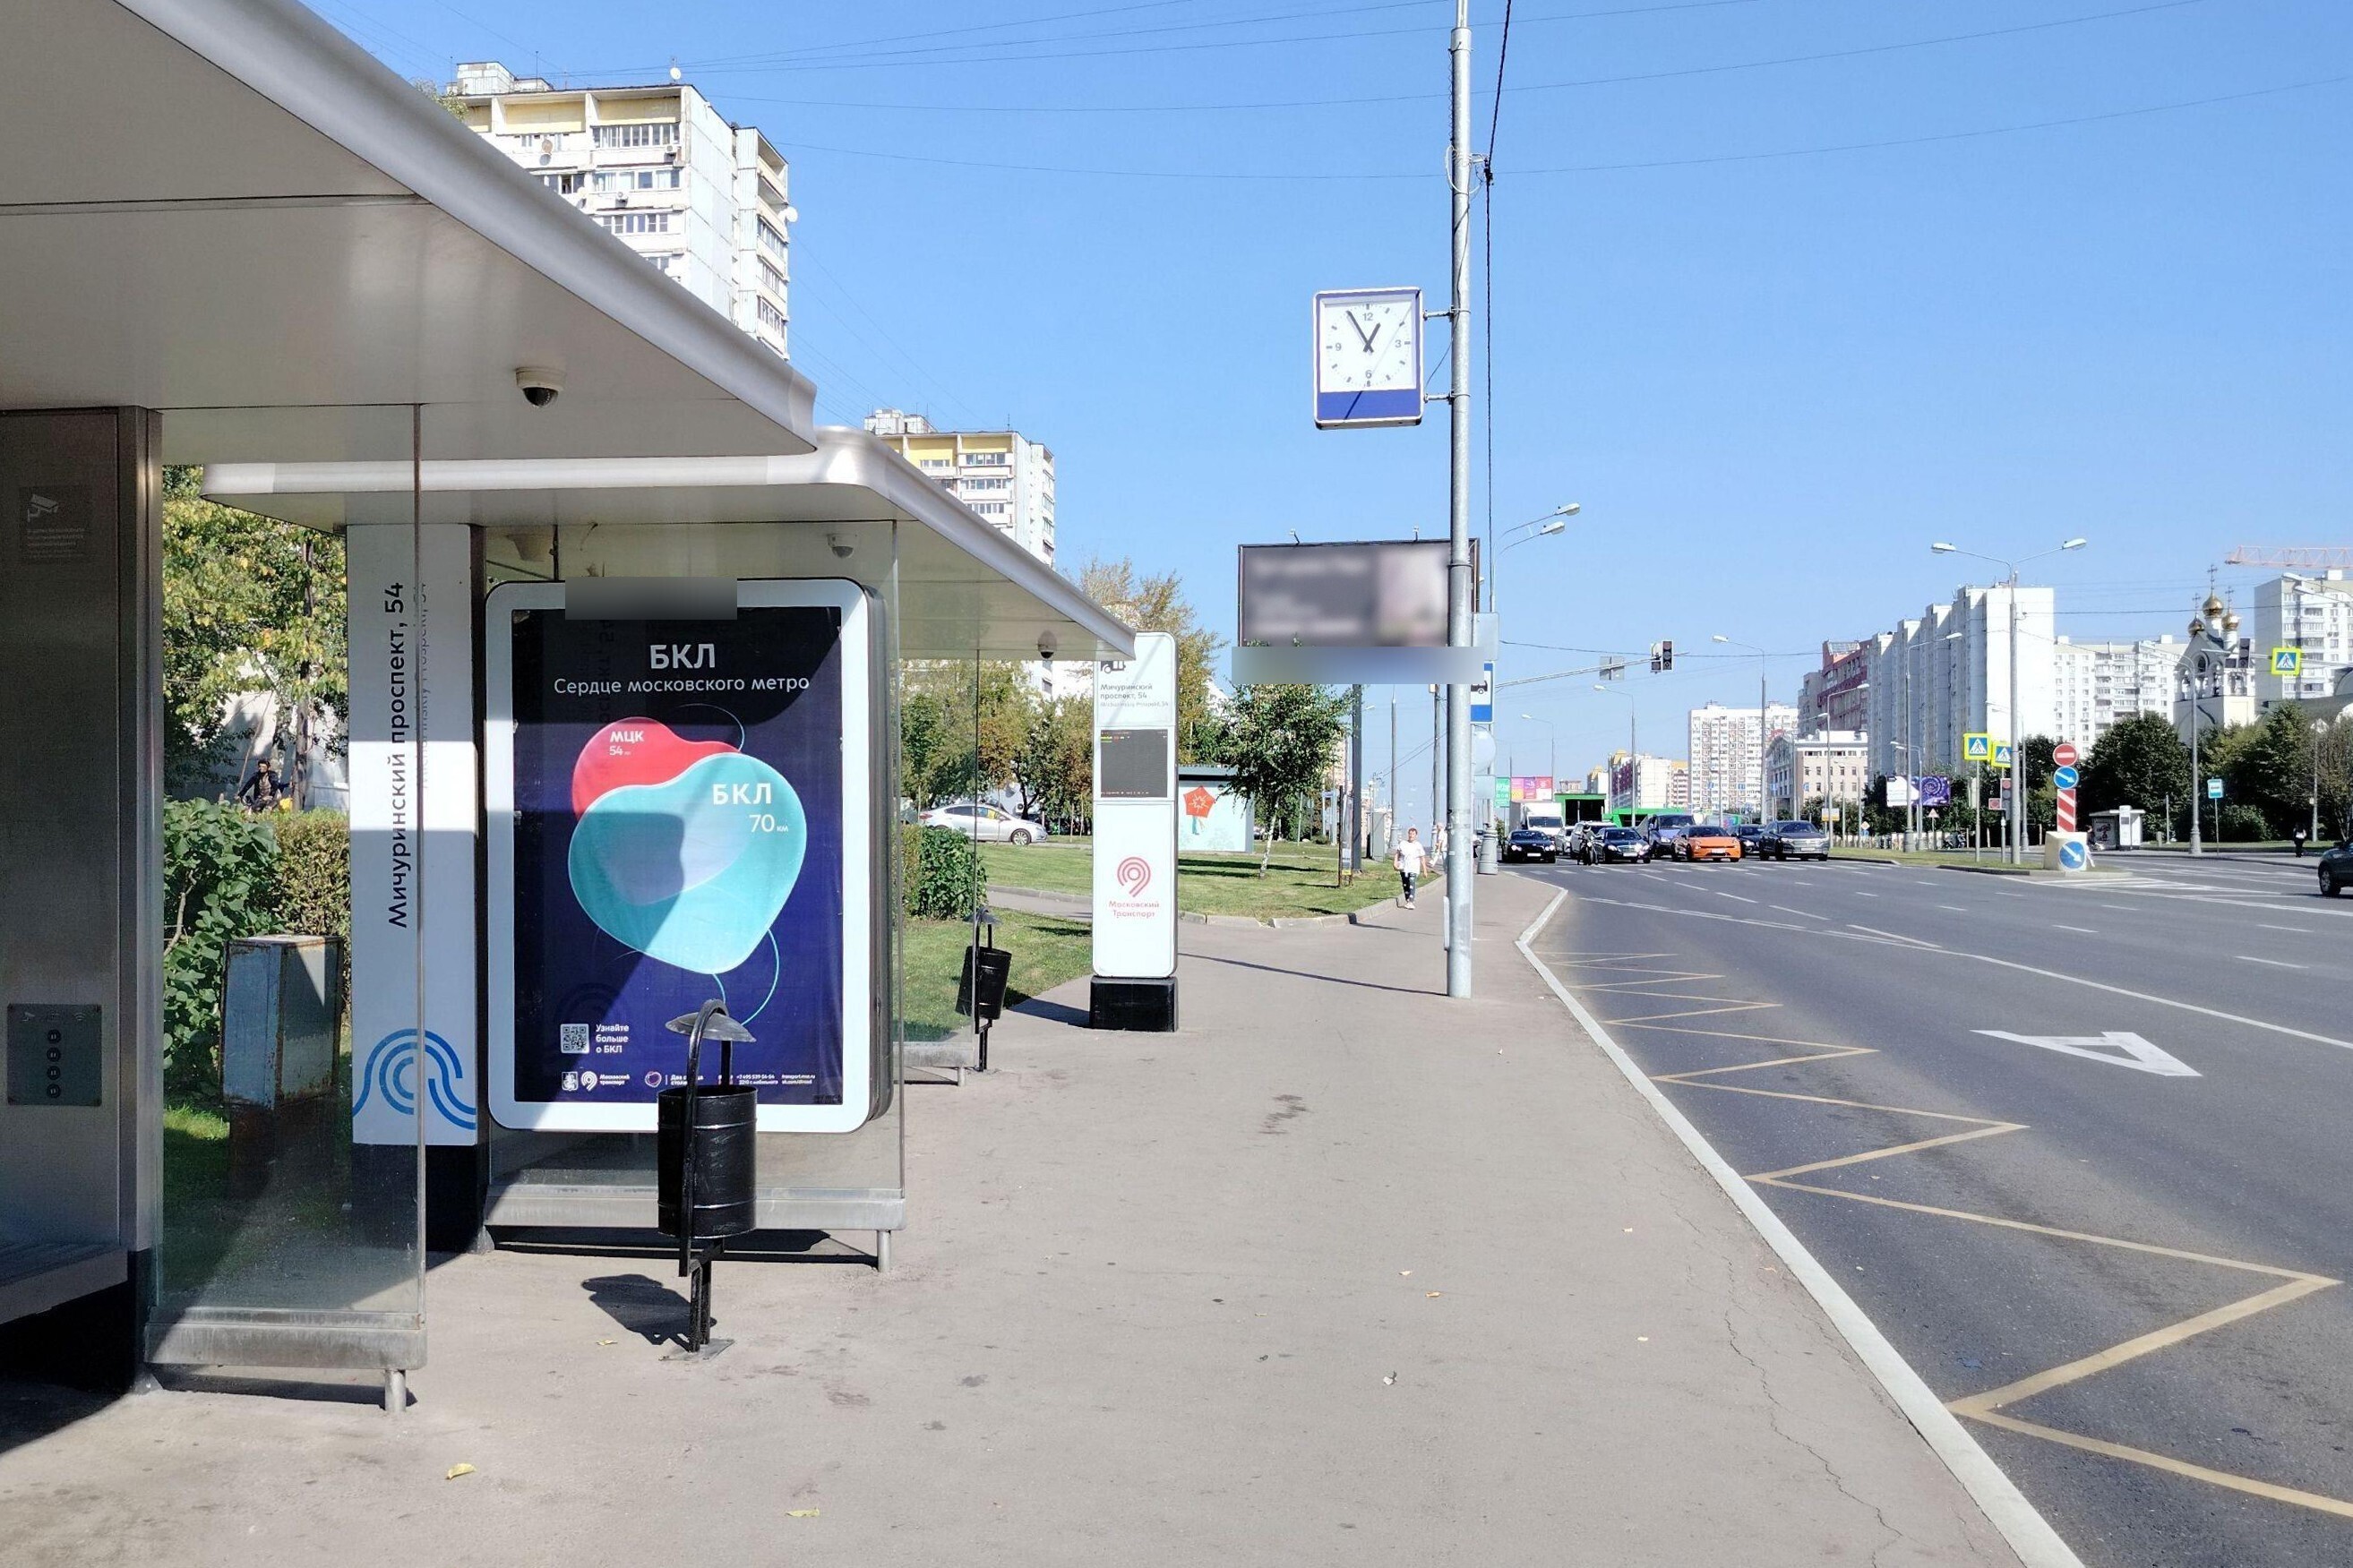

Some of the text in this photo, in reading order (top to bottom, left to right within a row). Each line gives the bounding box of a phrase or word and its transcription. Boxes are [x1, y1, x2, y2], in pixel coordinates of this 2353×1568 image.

[1362, 313, 1373, 321] 12
[1335, 343, 1342, 351] 9
[1395, 339, 1402, 348] 3
[1365, 370, 1372, 379] 6
[649, 643, 716, 670] БКЛ
[554, 676, 810, 696] Сердце московского метро
[1100, 683, 1153, 691] Мичуринский
[609, 731, 644, 743] МЦК
[609, 745, 623, 756] 54
[384, 582, 411, 929] Мичуринский проспект, 54
[712, 783, 772, 805] БКЛ
[749, 814, 789, 832] 70 км
[1108, 900, 1160, 908] Московский
[1112, 910, 1155, 919] Транспорт
[595, 1024, 630, 1032] Узнайте
[595, 1034, 629, 1042] больше
[604, 1045, 623, 1053] БКЛ
